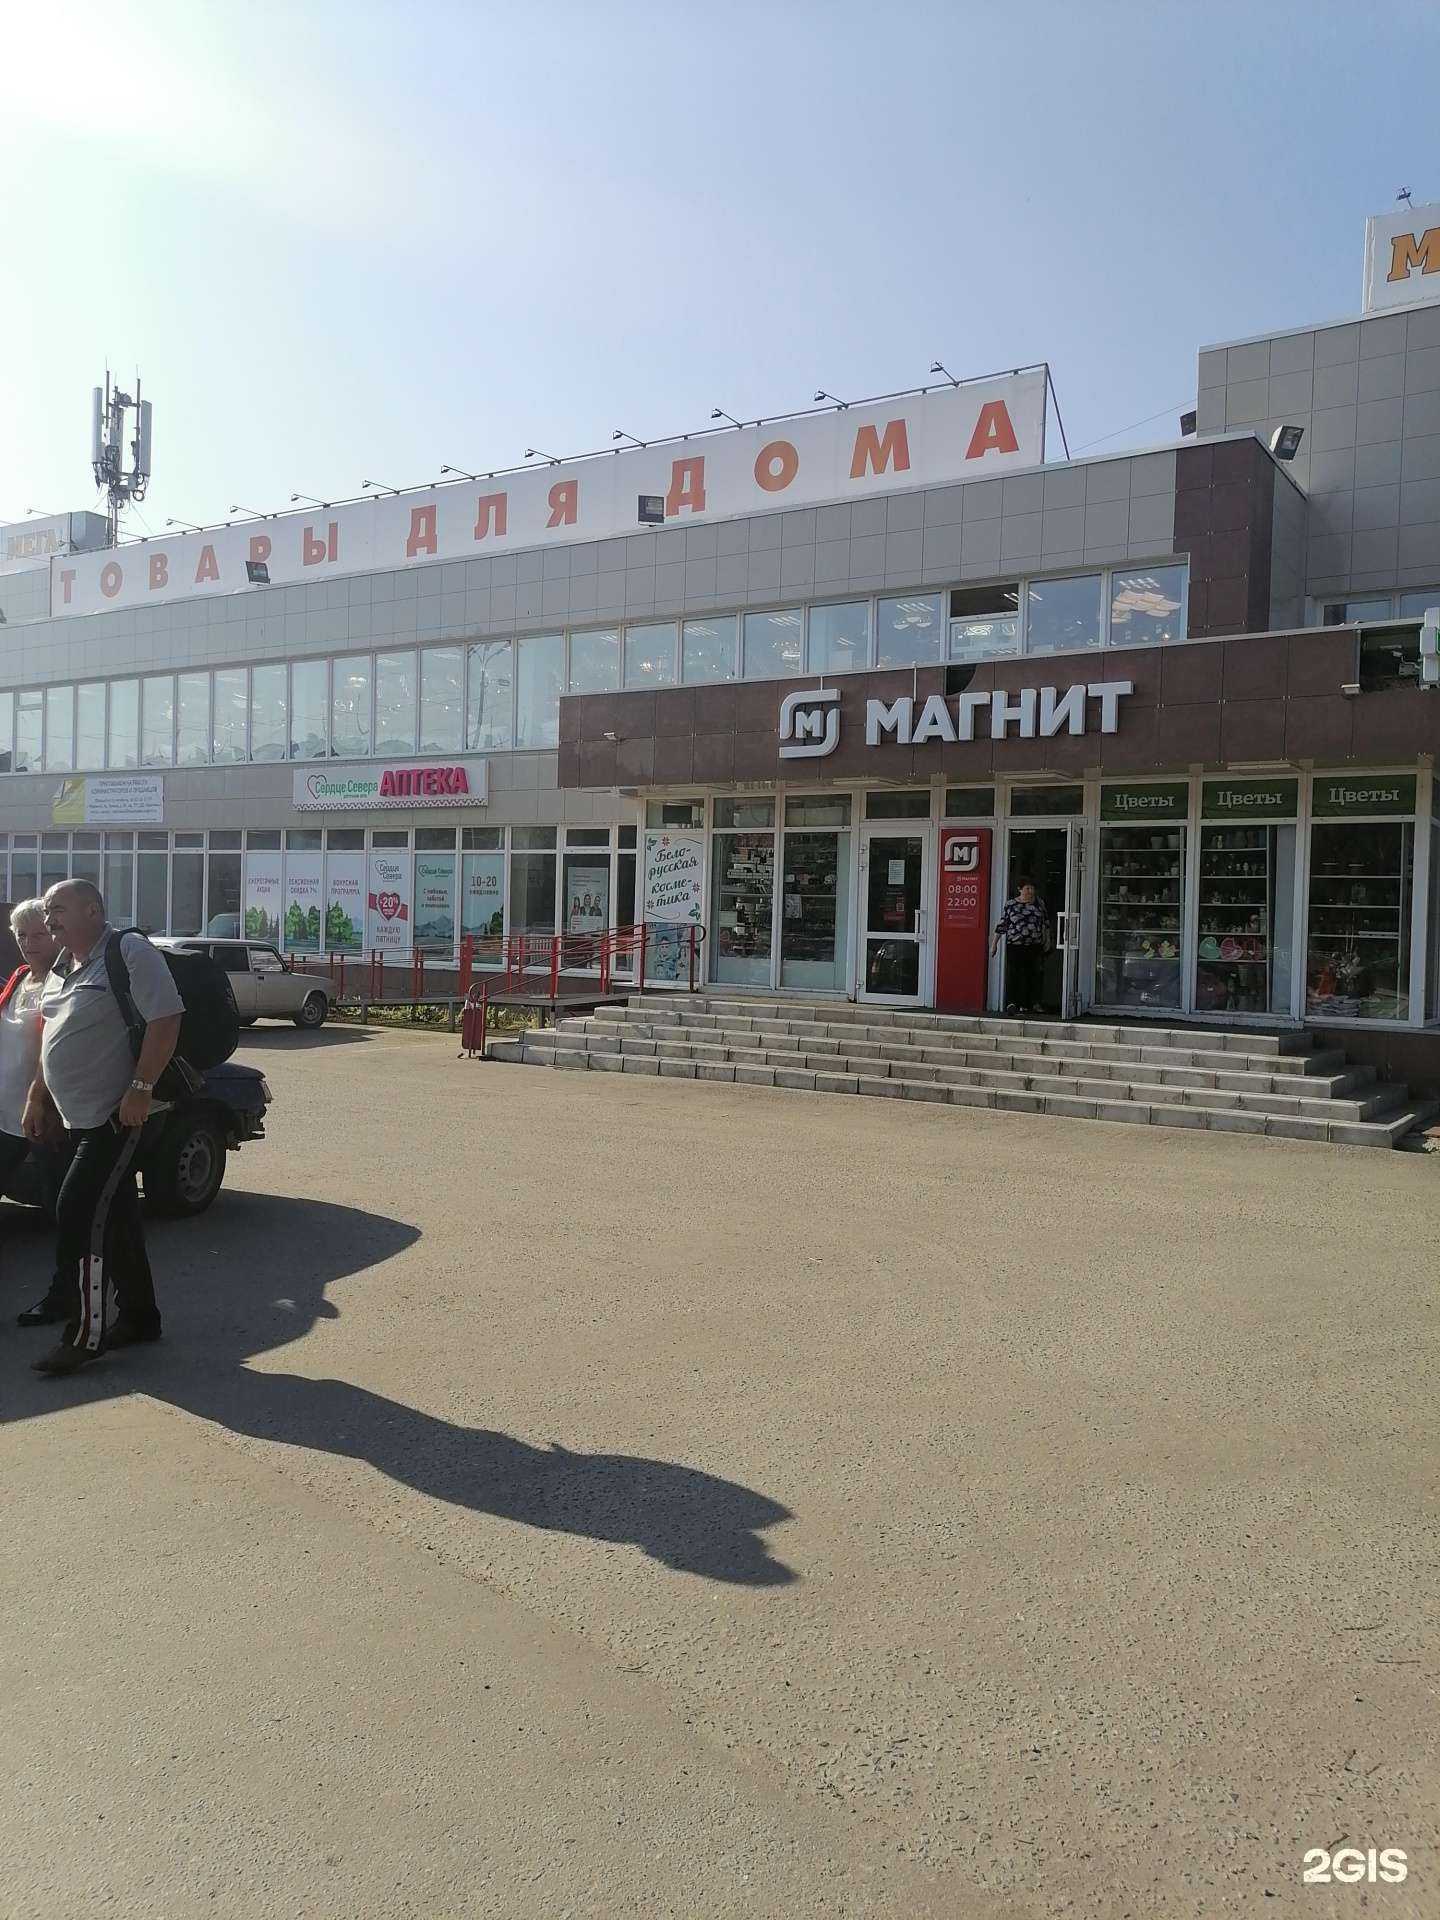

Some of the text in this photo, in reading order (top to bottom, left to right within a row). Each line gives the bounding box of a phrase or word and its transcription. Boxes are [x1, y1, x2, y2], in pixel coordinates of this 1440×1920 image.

[60, 400, 1019, 604] ТОВАРЫ ДЛЯ ДОМА
[866, 681, 1133, 745] МАГНИТ
[315, 779, 378, 796] Сердце Севера
[379, 767, 469, 797] АПТЕКА
[1114, 794, 1175, 810] Цветы
[1217, 791, 1282, 807] Цветы
[1328, 787, 1400, 805] Цветы
[655, 847, 691, 862] Бело-
[648, 856, 699, 880] русская
[472, 876, 497, 887] 10-20
[948, 885, 978, 894] 08:00
[656, 891, 690, 906] тика
[947, 897, 977, 906] 22:00
